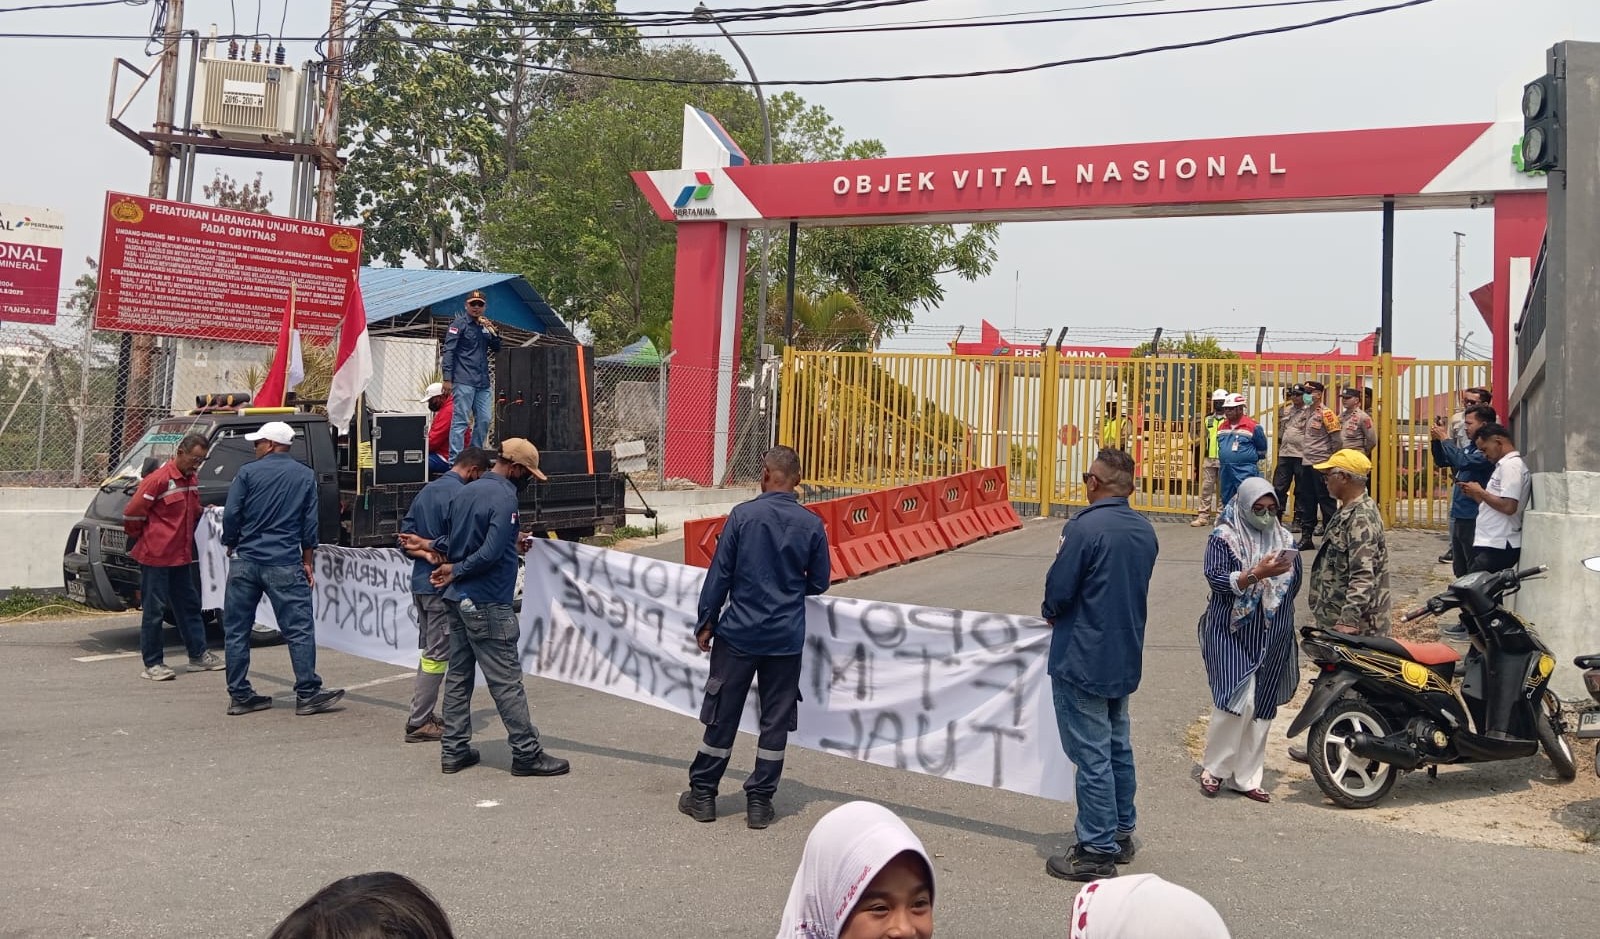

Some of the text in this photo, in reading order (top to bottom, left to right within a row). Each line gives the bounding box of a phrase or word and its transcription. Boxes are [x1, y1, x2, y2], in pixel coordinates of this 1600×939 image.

[833, 153, 1286, 195] OBJEK VITAL NASIONAL
[673, 208, 716, 216] PERTAMINA
[150, 204, 326, 237] PERATURAN LARANGAN UNJUK RASA
[200, 223, 276, 242] PADA OBVITNAS
[215, 241, 240, 249] TENTANG
[285, 250, 311, 258] PENDAPAT
[3, 305, 31, 314] TANPA
[1014, 348, 1108, 358] PERMINA
[1584, 714, 1598, 724] DE
